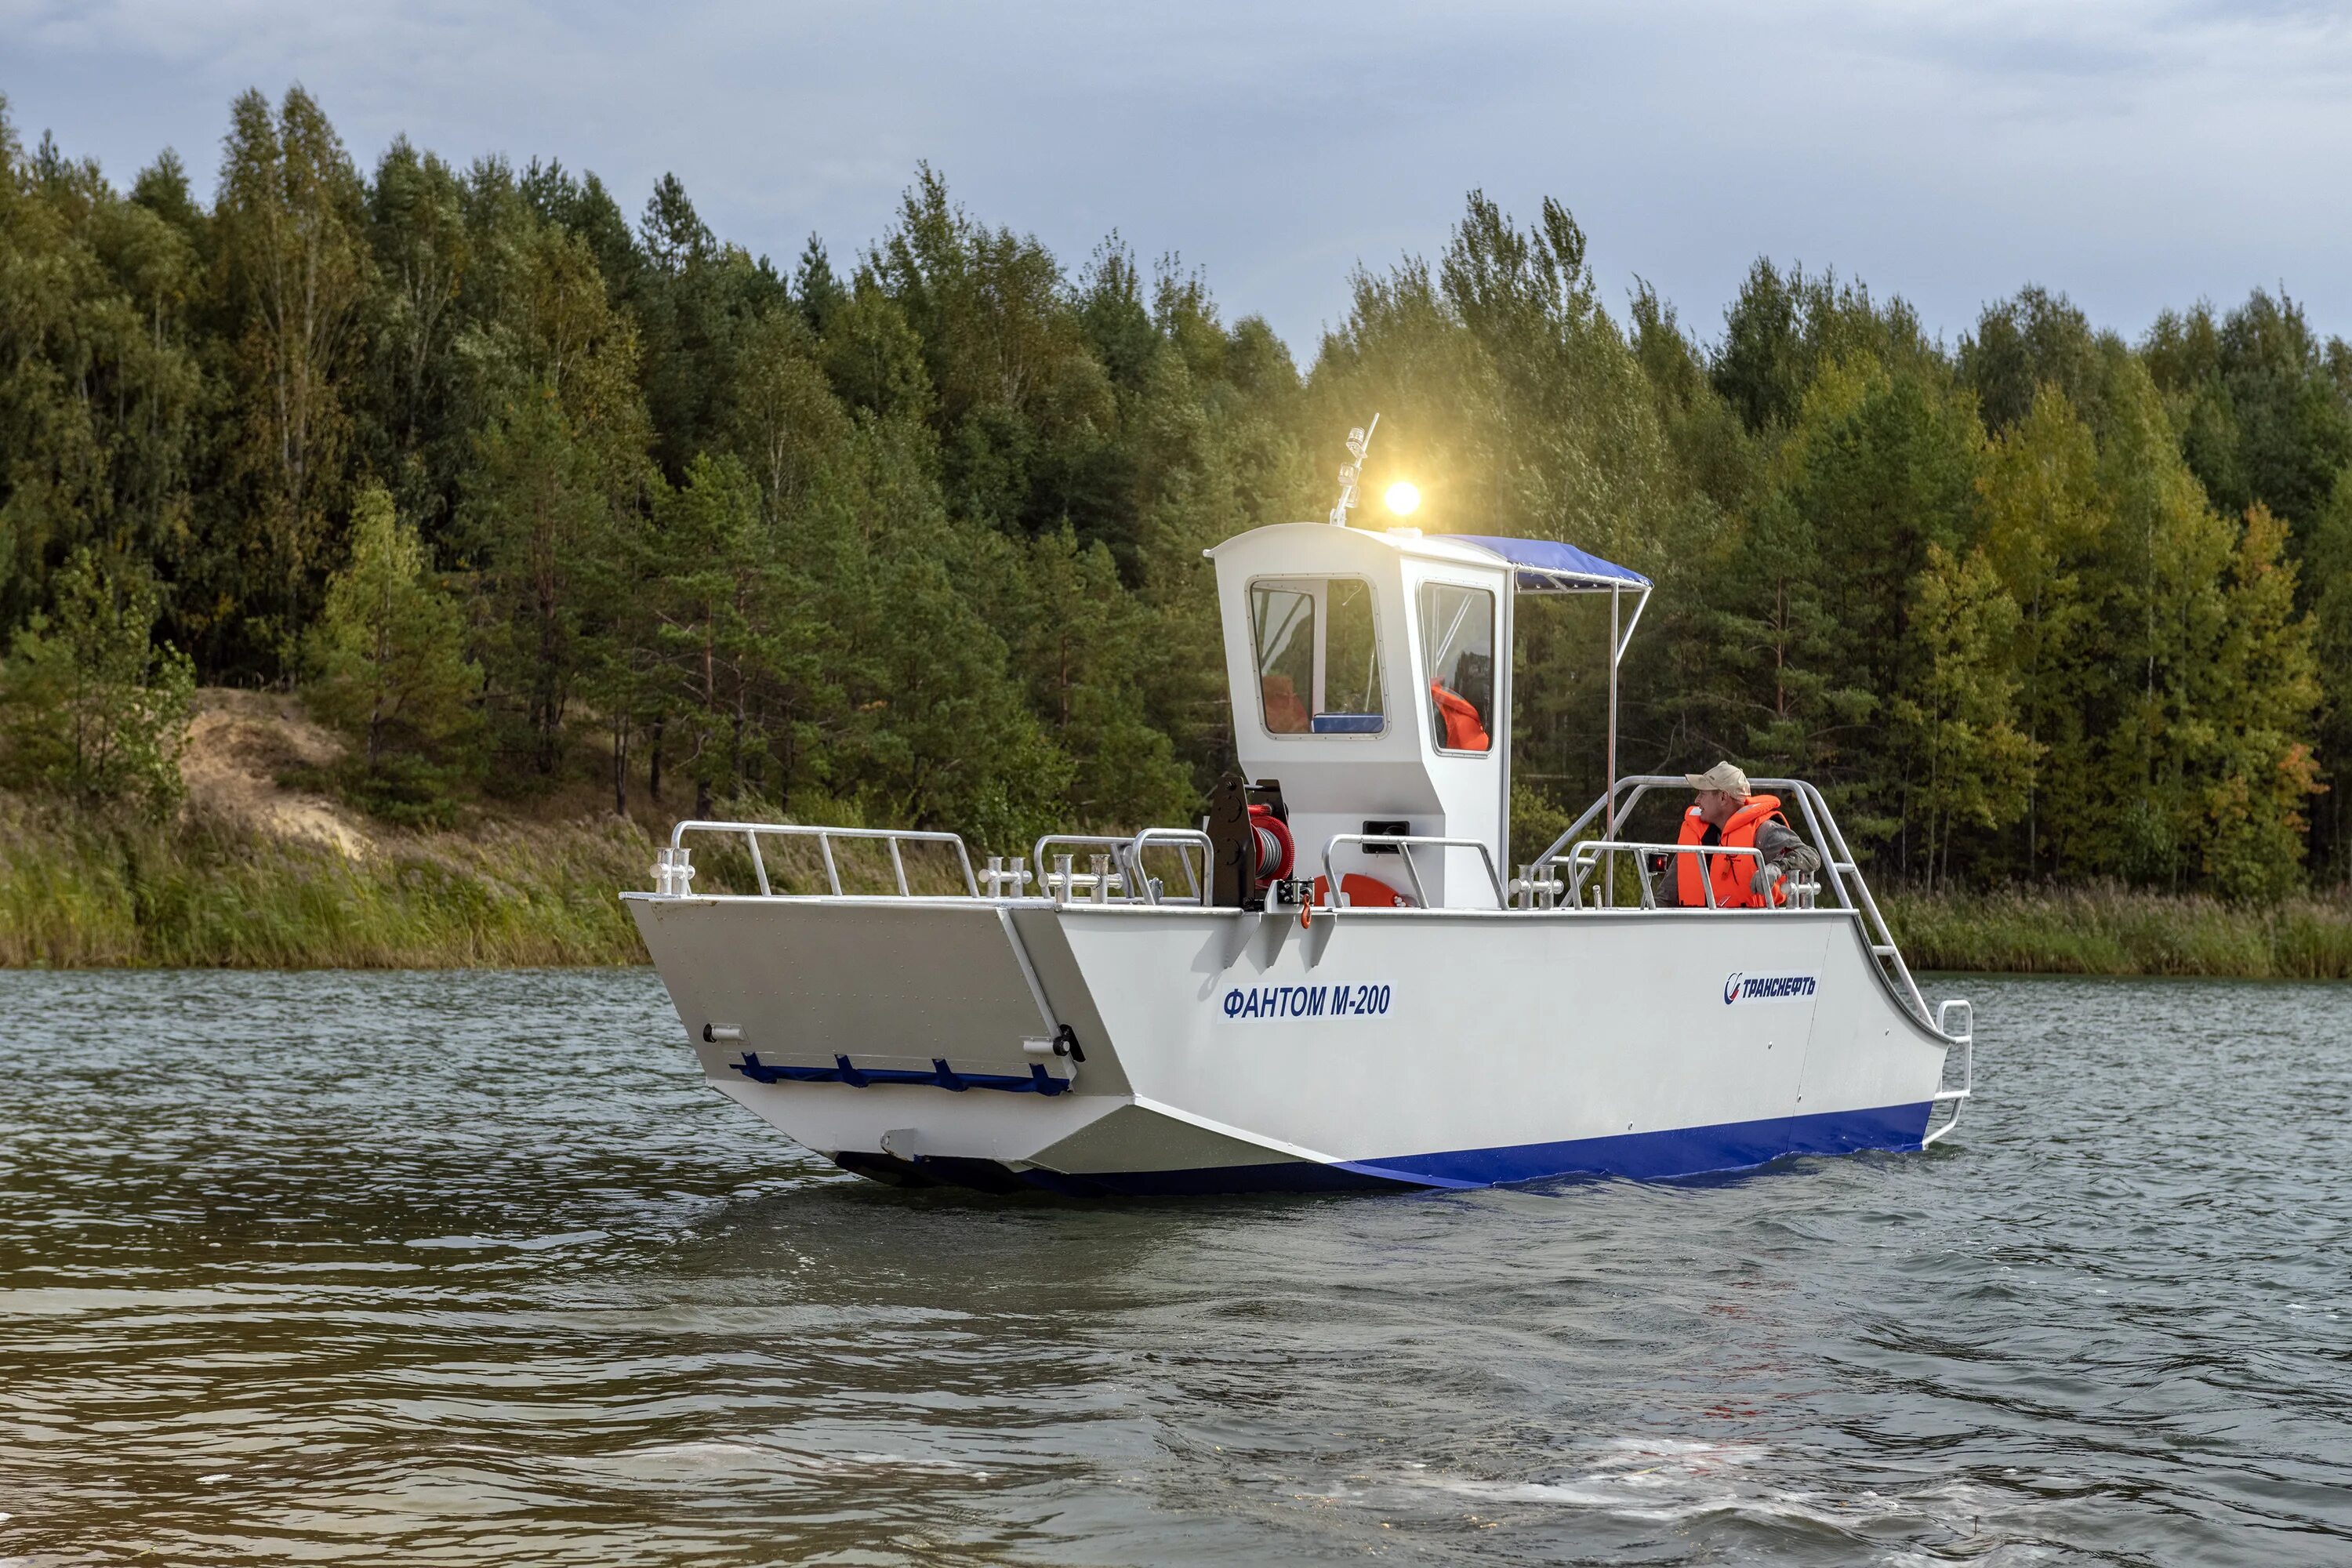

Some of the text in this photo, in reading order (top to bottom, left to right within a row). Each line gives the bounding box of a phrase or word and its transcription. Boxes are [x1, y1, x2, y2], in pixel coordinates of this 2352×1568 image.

[1742, 977, 1816, 998] ТРАНСНЕФТЬ
[1224, 985, 1390, 1018] ФАНТОМ М-200
